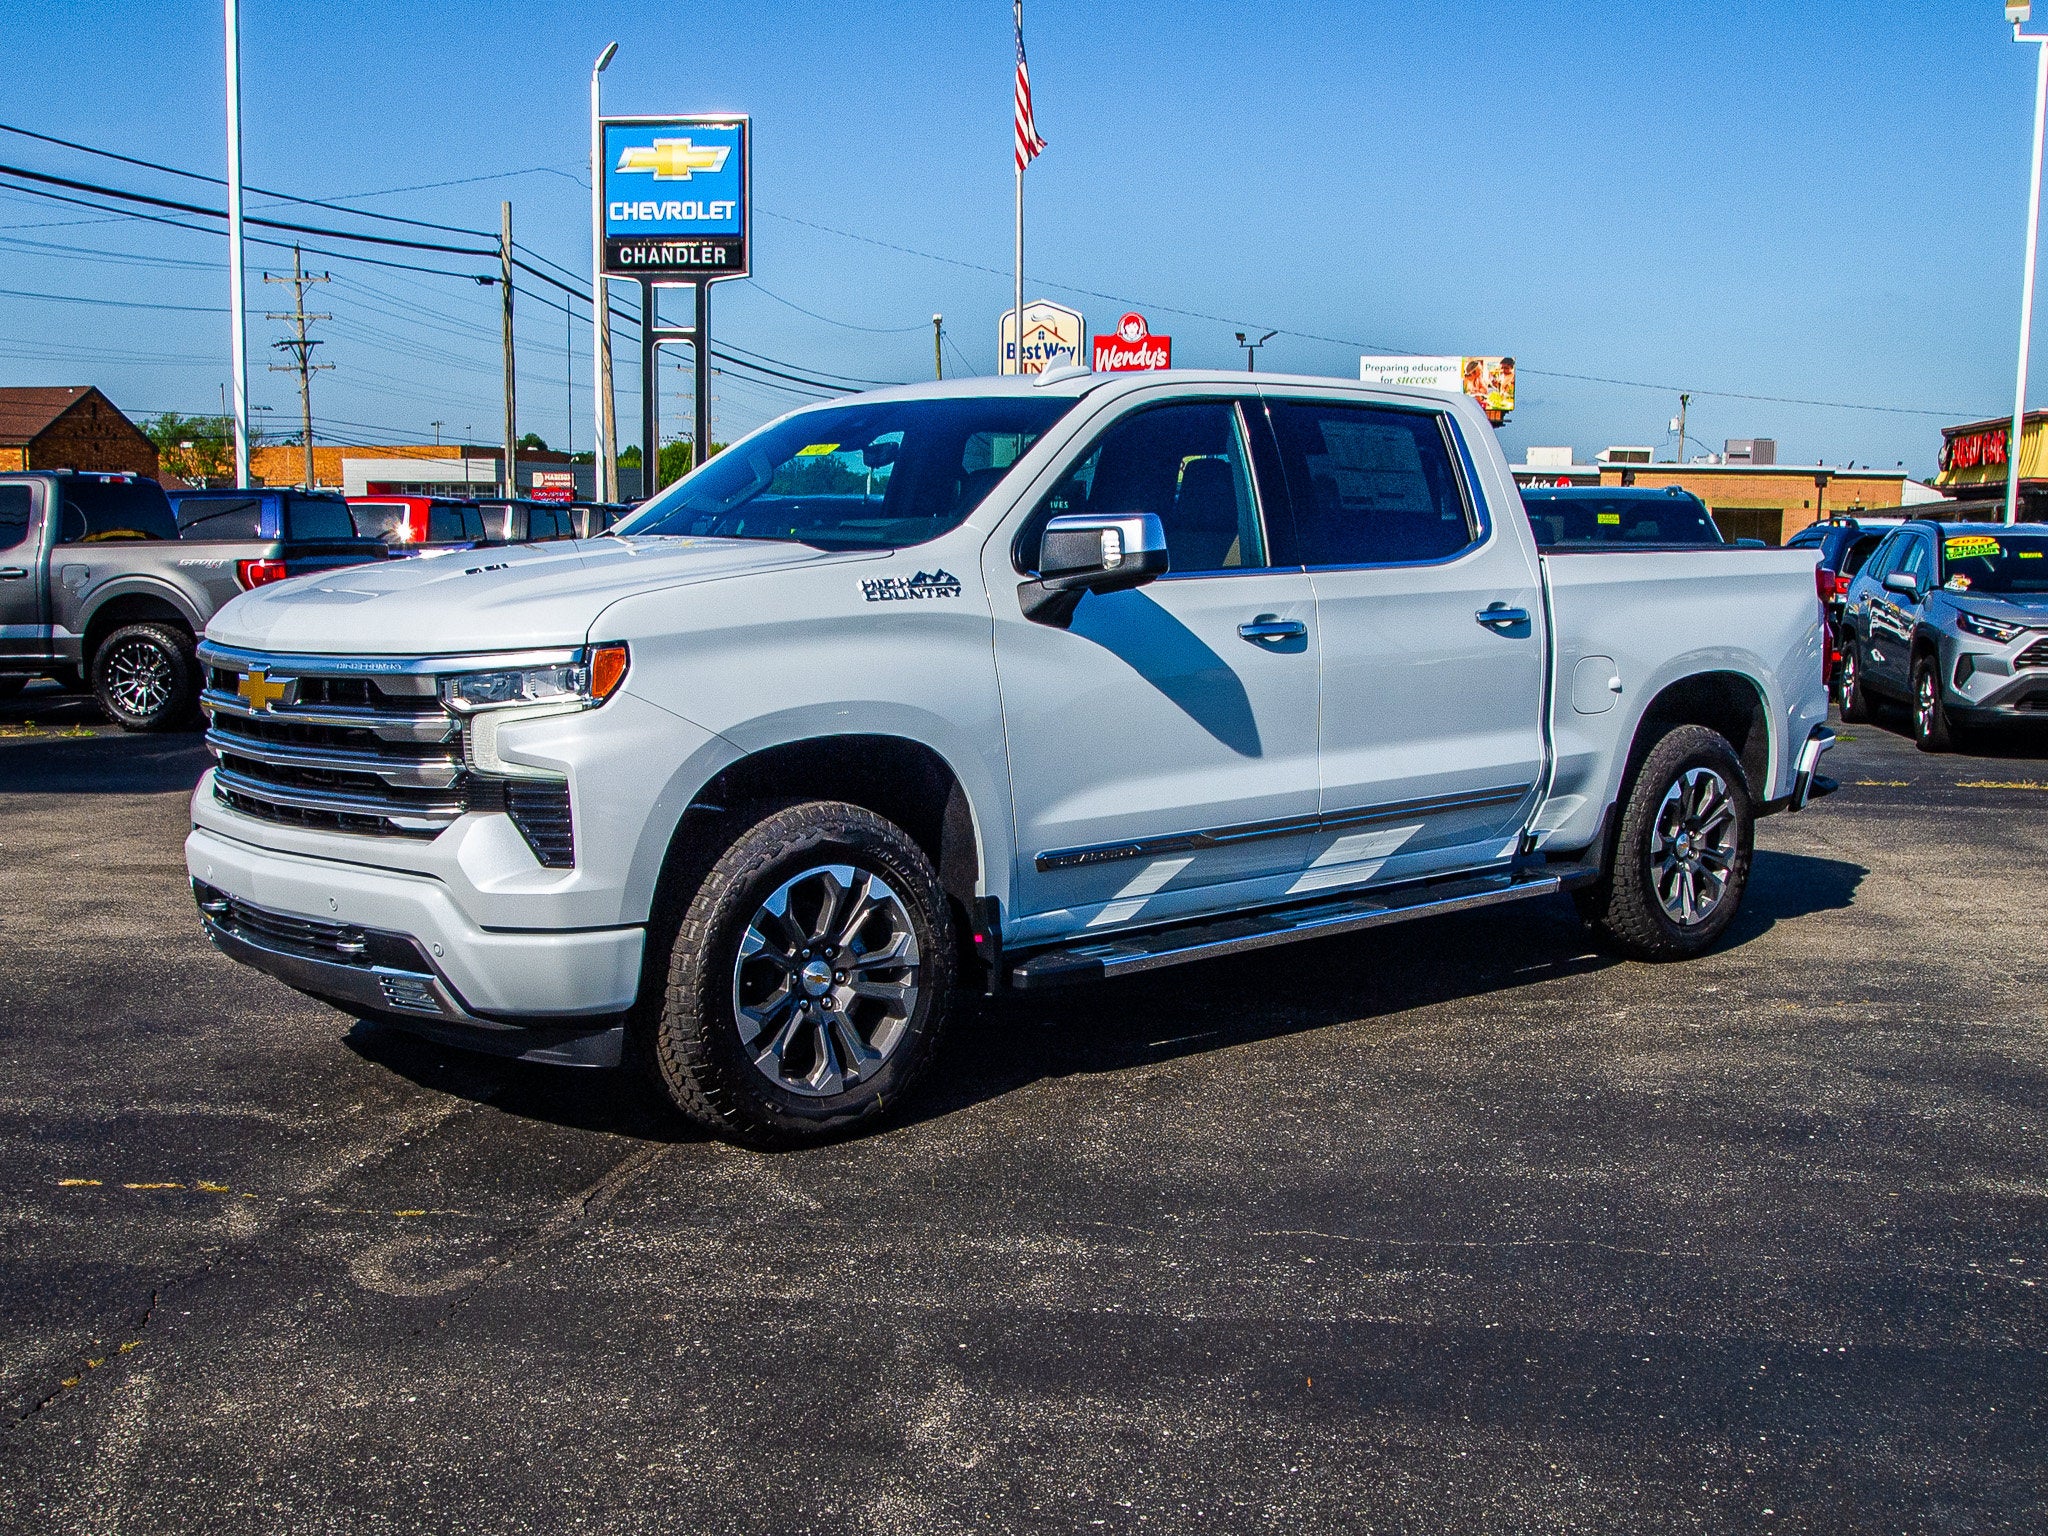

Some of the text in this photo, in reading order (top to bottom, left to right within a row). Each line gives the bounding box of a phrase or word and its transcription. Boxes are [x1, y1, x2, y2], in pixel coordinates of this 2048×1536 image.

[609, 201, 736, 221] CHEVROLET
[619, 247, 727, 264] CHANDLER
[1095, 342, 1168, 371] Wendy's
[1023, 362, 1048, 375] IN
[1365, 363, 1457, 374] Preparing educators
[1380, 376, 1438, 385] for success
[862, 586, 962, 602] COUNTRY
